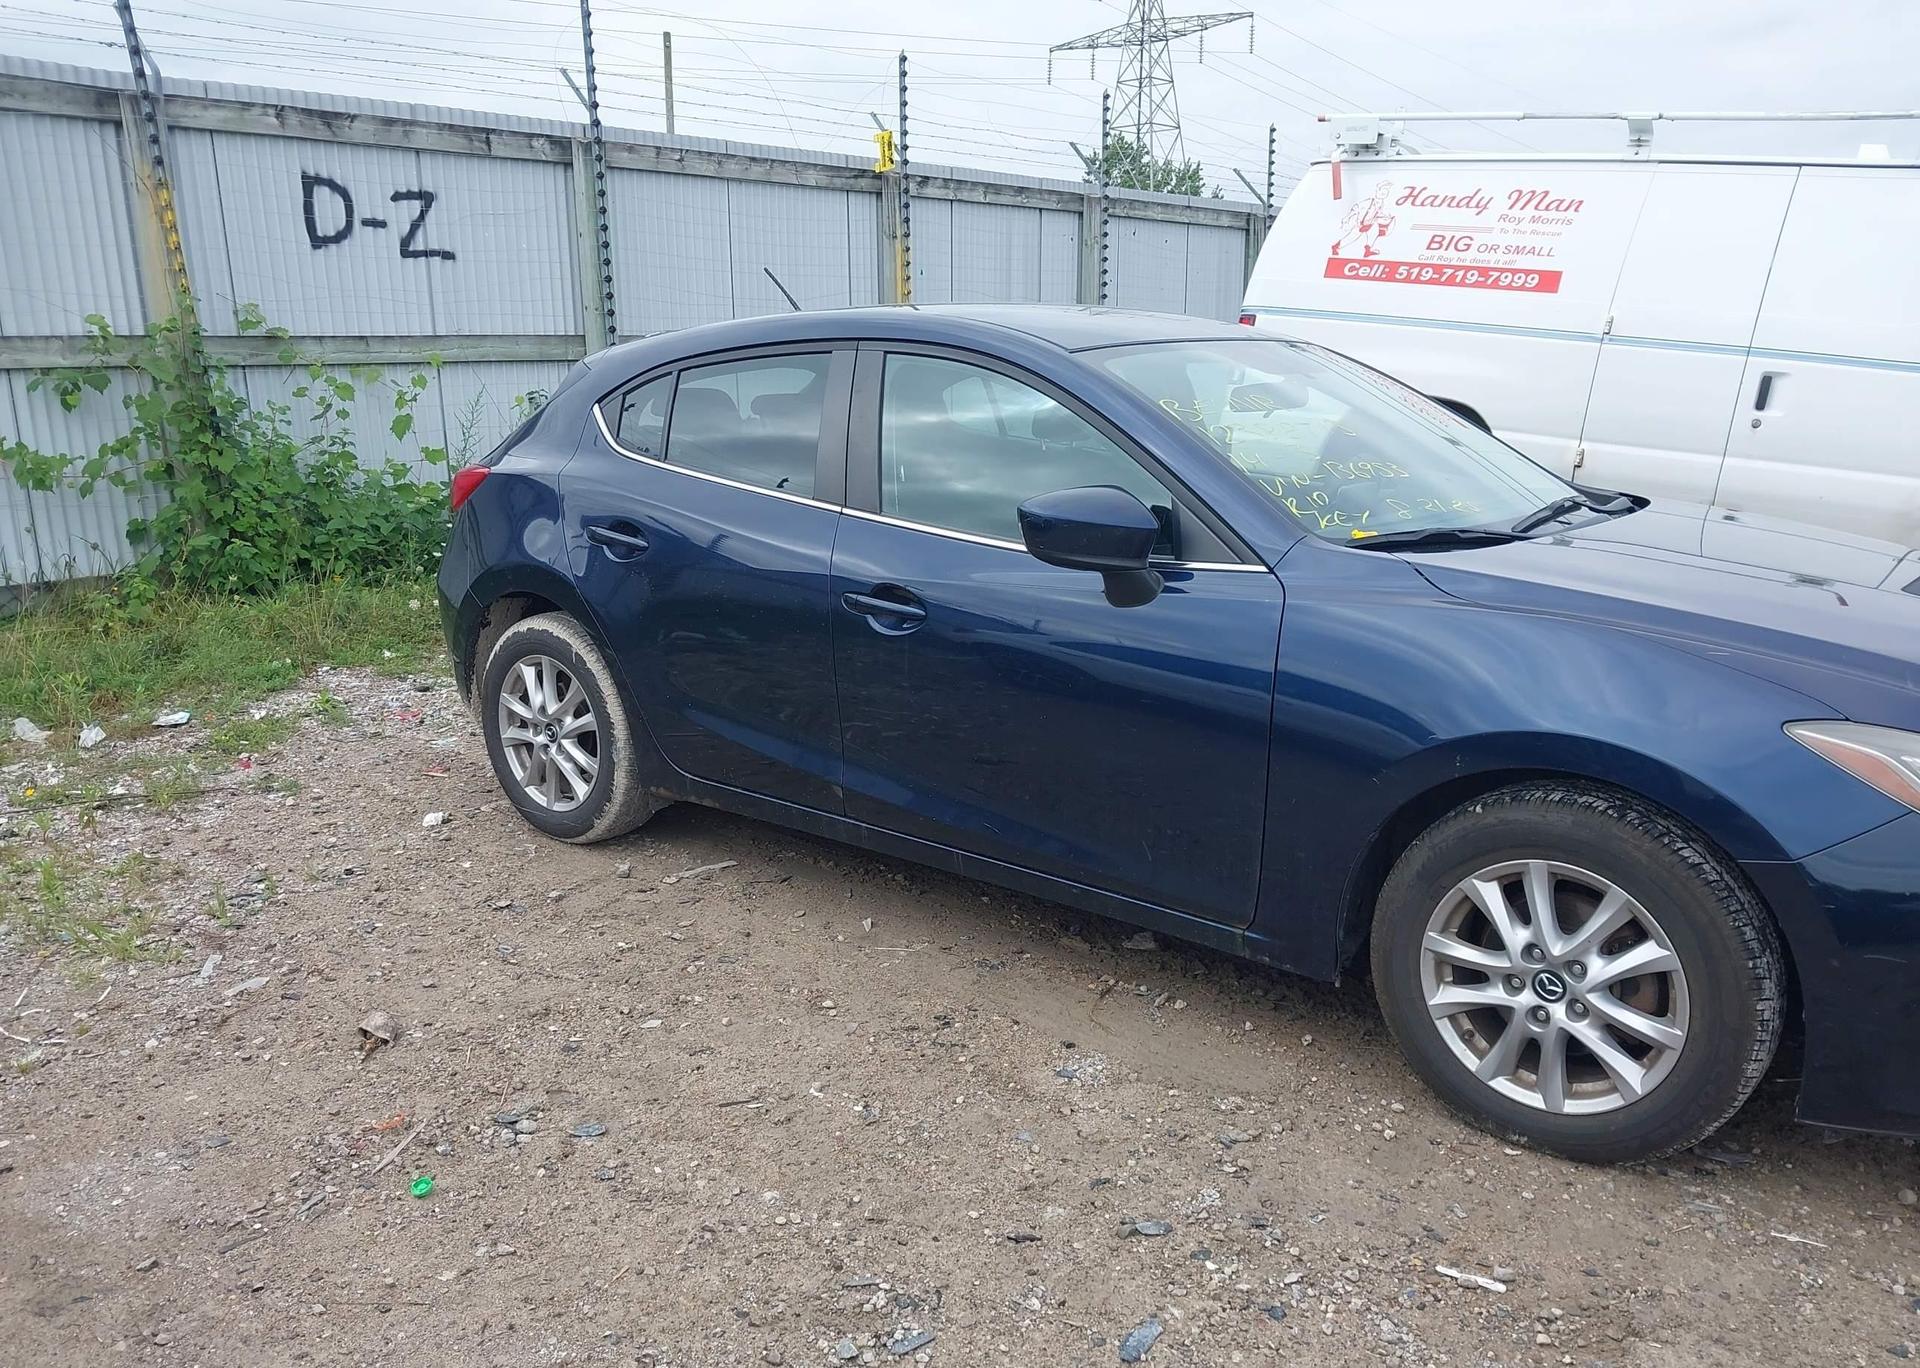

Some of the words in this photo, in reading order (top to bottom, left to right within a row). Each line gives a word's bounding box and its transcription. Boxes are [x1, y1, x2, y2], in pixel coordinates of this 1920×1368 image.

[1395, 185, 1494, 216] Handy
[1507, 189, 1584, 213] Man
[301, 171, 456, 261] D-Z
[1497, 213, 1526, 226] Roy
[1528, 215, 1574, 226] Morris
[1499, 227, 1510, 235] To
[1512, 228, 1528, 236] The
[1529, 228, 1562, 237] Rescue
[1426, 234, 1474, 253] BIG
[1476, 243, 1501, 255] OR
[1502, 244, 1556, 258] SMALL
[1418, 254, 1435, 262] Call
[1436, 255, 1454, 264] Roy
[1469, 256, 1491, 265] does
[1343, 262, 1390, 279] Cell:
[1395, 265, 1540, 288] 519-719-7999
